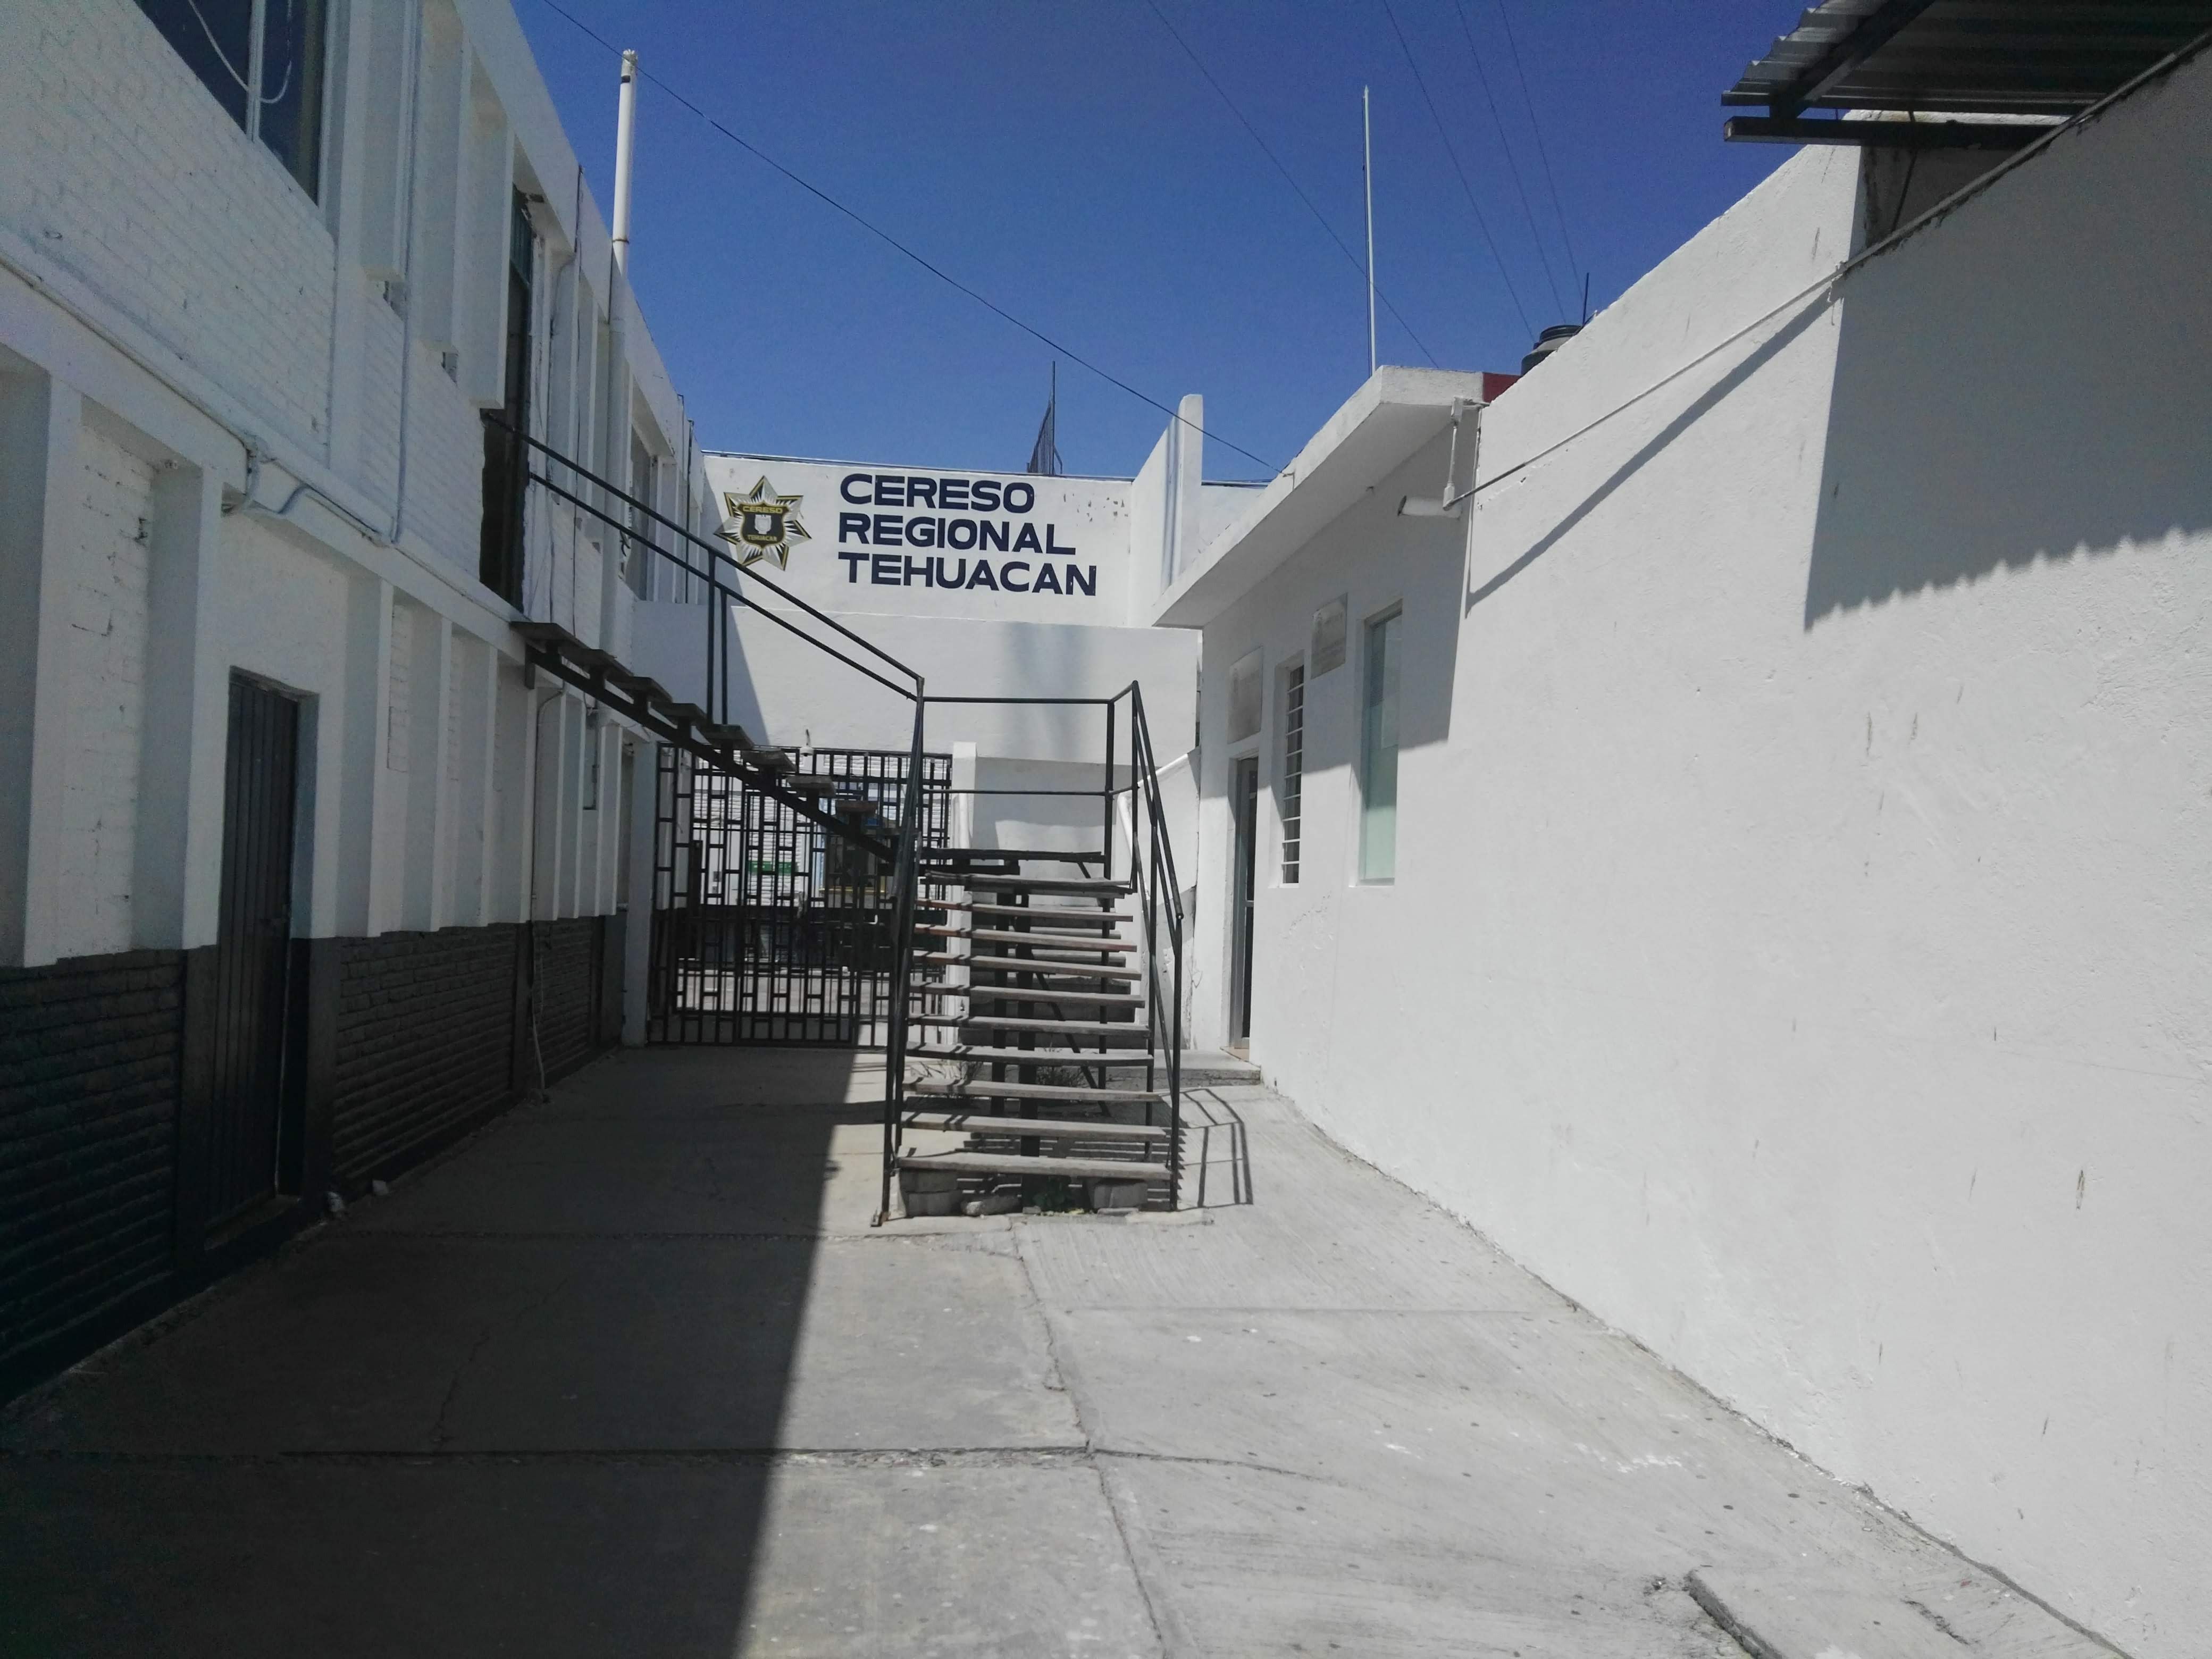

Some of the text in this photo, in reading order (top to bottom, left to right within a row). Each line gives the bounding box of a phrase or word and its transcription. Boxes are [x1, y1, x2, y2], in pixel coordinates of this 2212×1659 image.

[840, 473, 1035, 514] CERESO
[838, 512, 1077, 556] REGIONAL
[838, 551, 1097, 596] TEHUACAN
